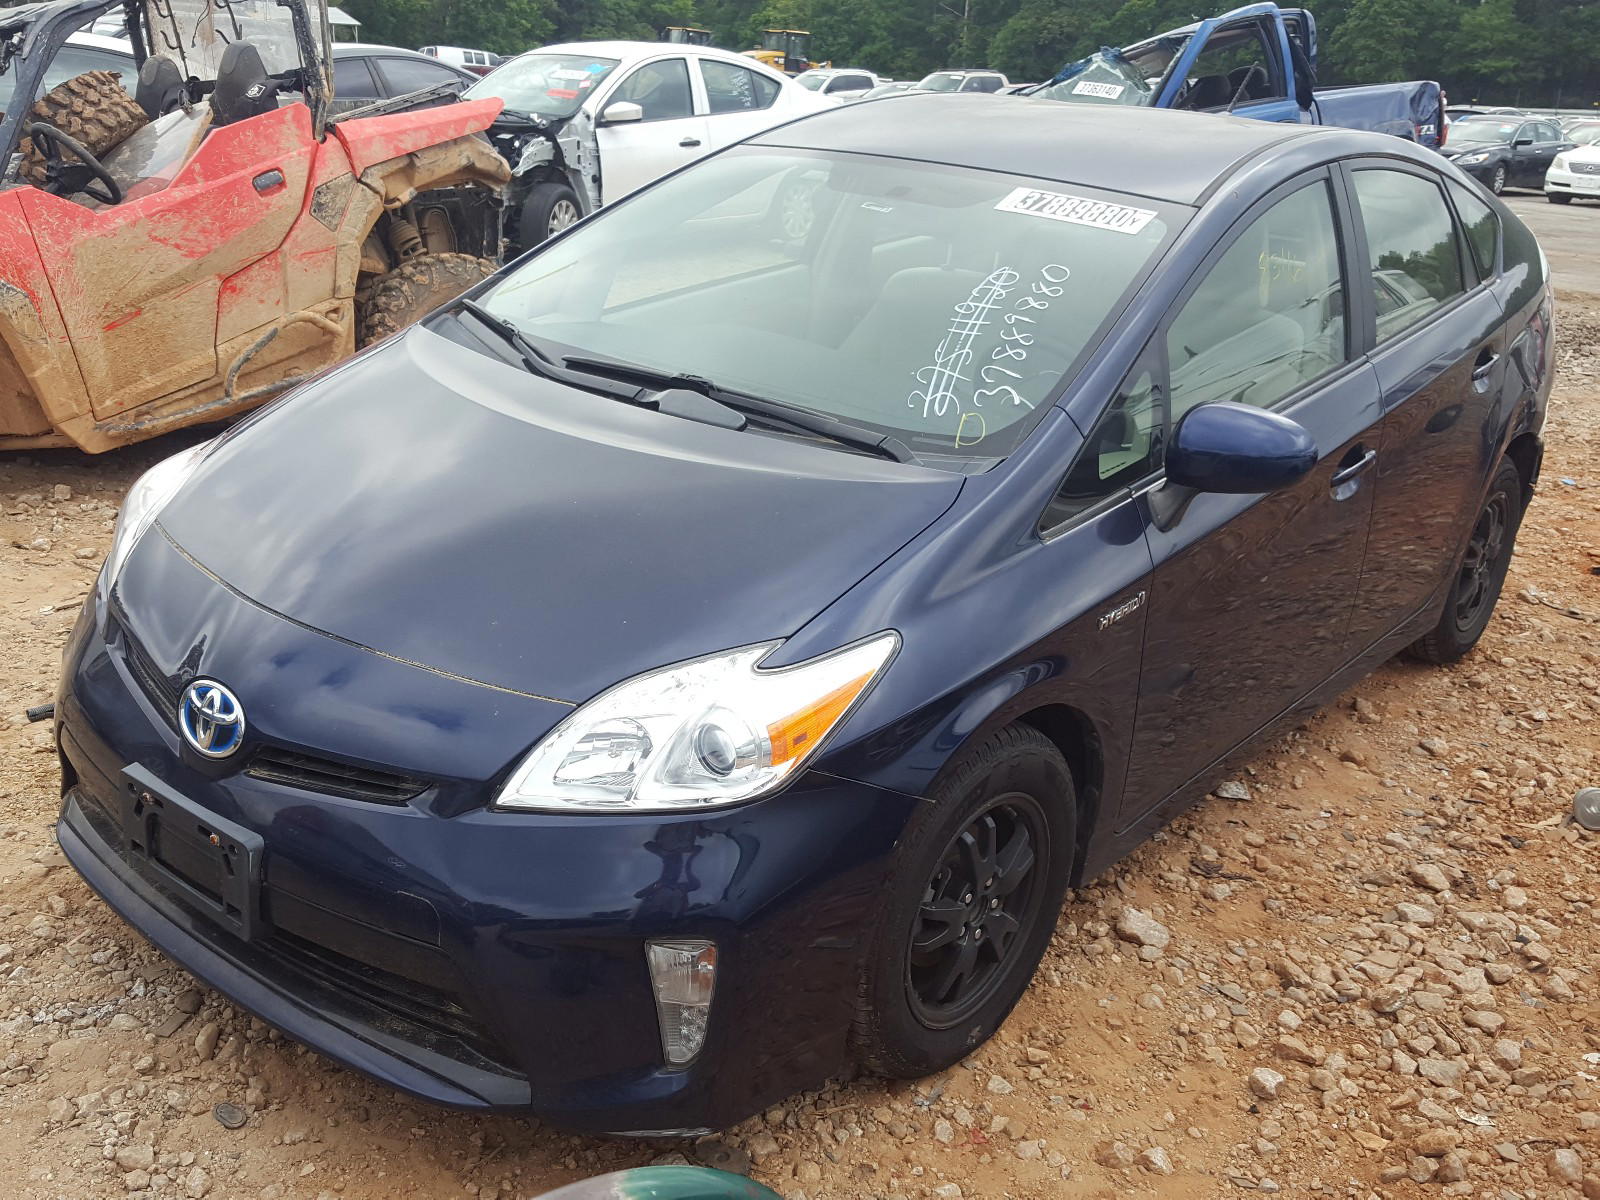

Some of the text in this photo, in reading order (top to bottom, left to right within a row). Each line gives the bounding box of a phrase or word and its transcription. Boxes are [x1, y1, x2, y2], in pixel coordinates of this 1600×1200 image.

[1015, 191, 1138, 228] 37889880
[974, 264, 1070, 408] 37889880
[955, 412, 985, 448] D
[1098, 590, 1146, 631] HYBRID
